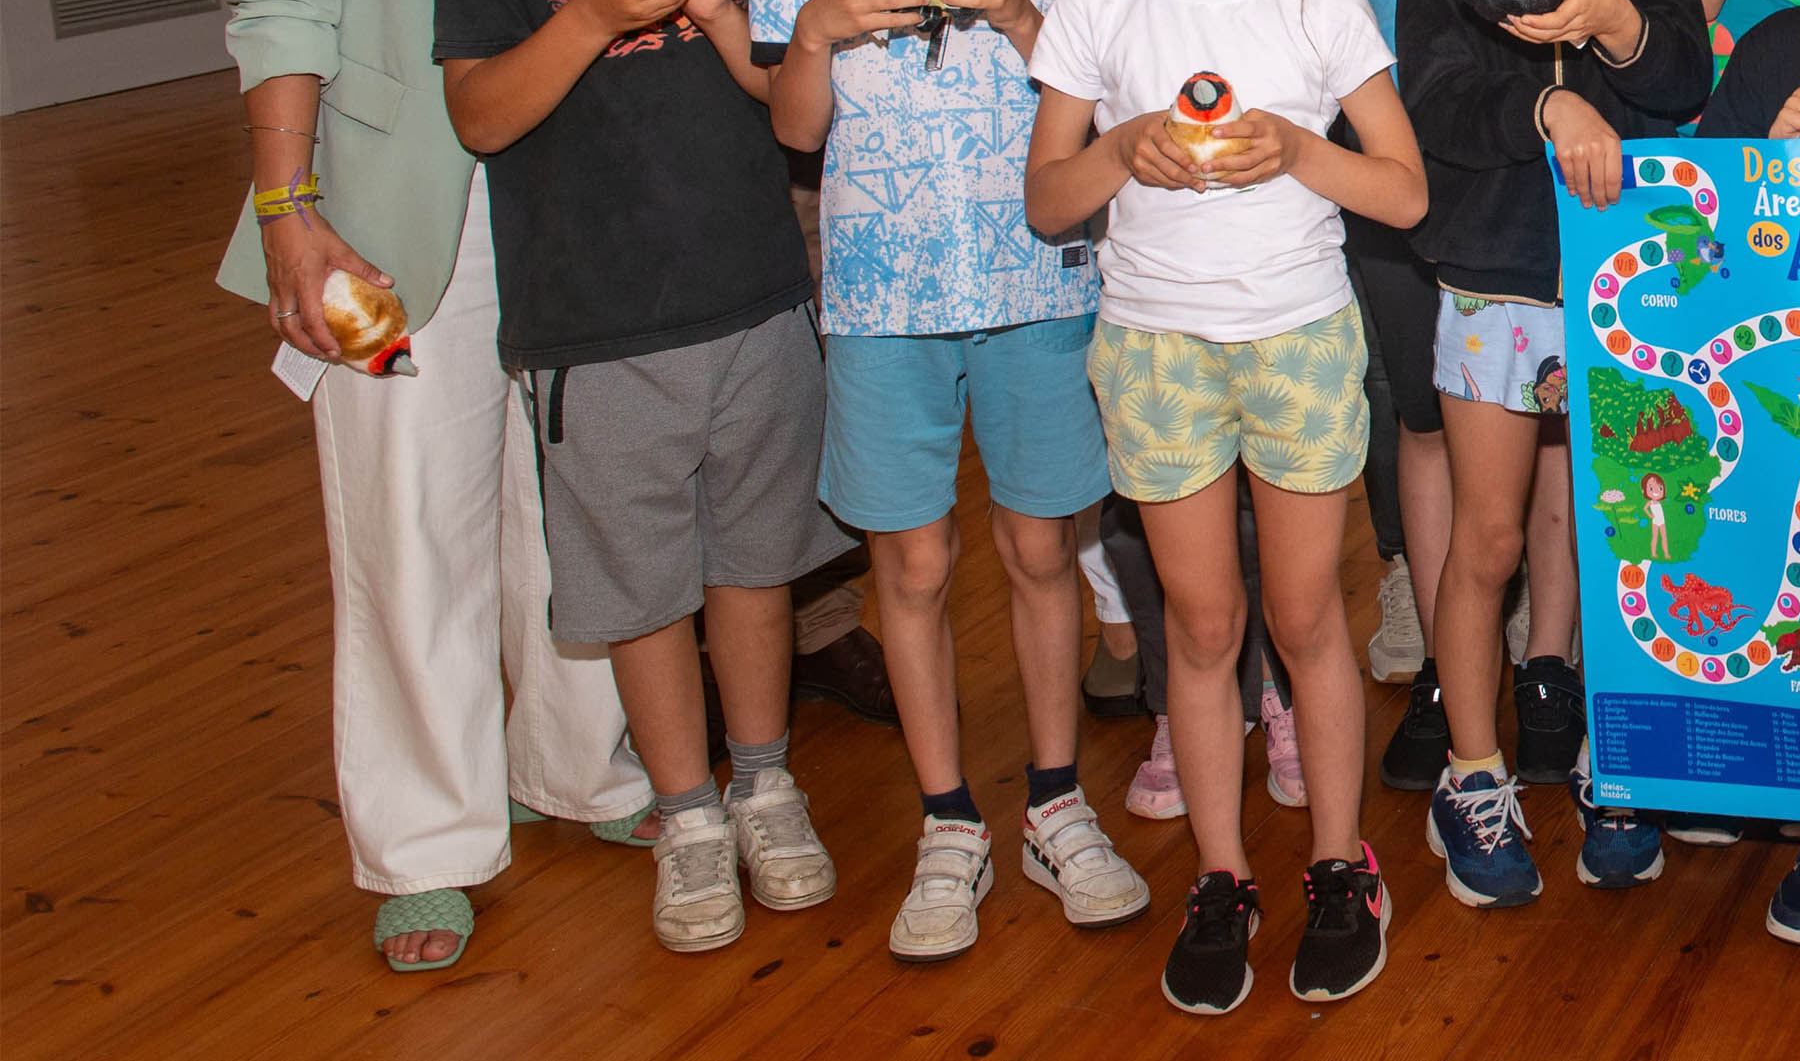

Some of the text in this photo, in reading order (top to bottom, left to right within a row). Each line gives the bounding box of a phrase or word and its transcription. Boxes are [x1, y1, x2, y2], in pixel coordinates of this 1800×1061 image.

[1646, 162, 1656, 180] ?
[1676, 168, 1694, 181] V/F
[1752, 227, 1784, 251] dos
[1649, 244, 1657, 263] ?
[1617, 259, 1634, 271] V/F
[1641, 293, 1678, 308] CORVO
[1599, 306, 1609, 327] ?
[1767, 319, 1775, 338] ?
[1610, 336, 1628, 348] V/F
[1736, 331, 1752, 345] +2
[1668, 354, 1676, 373] ?
[1711, 388, 1726, 401] V/F
[1723, 440, 1732, 460] ?
[1708, 507, 1747, 523] FLORES
[1624, 571, 1641, 583] V/F
[1641, 620, 1649, 639] ?
[1656, 644, 1673, 655] V/F
[1751, 647, 1767, 660] V/F
[1735, 656, 1743, 675] ?
[1041, 797, 1079, 819] adidas
